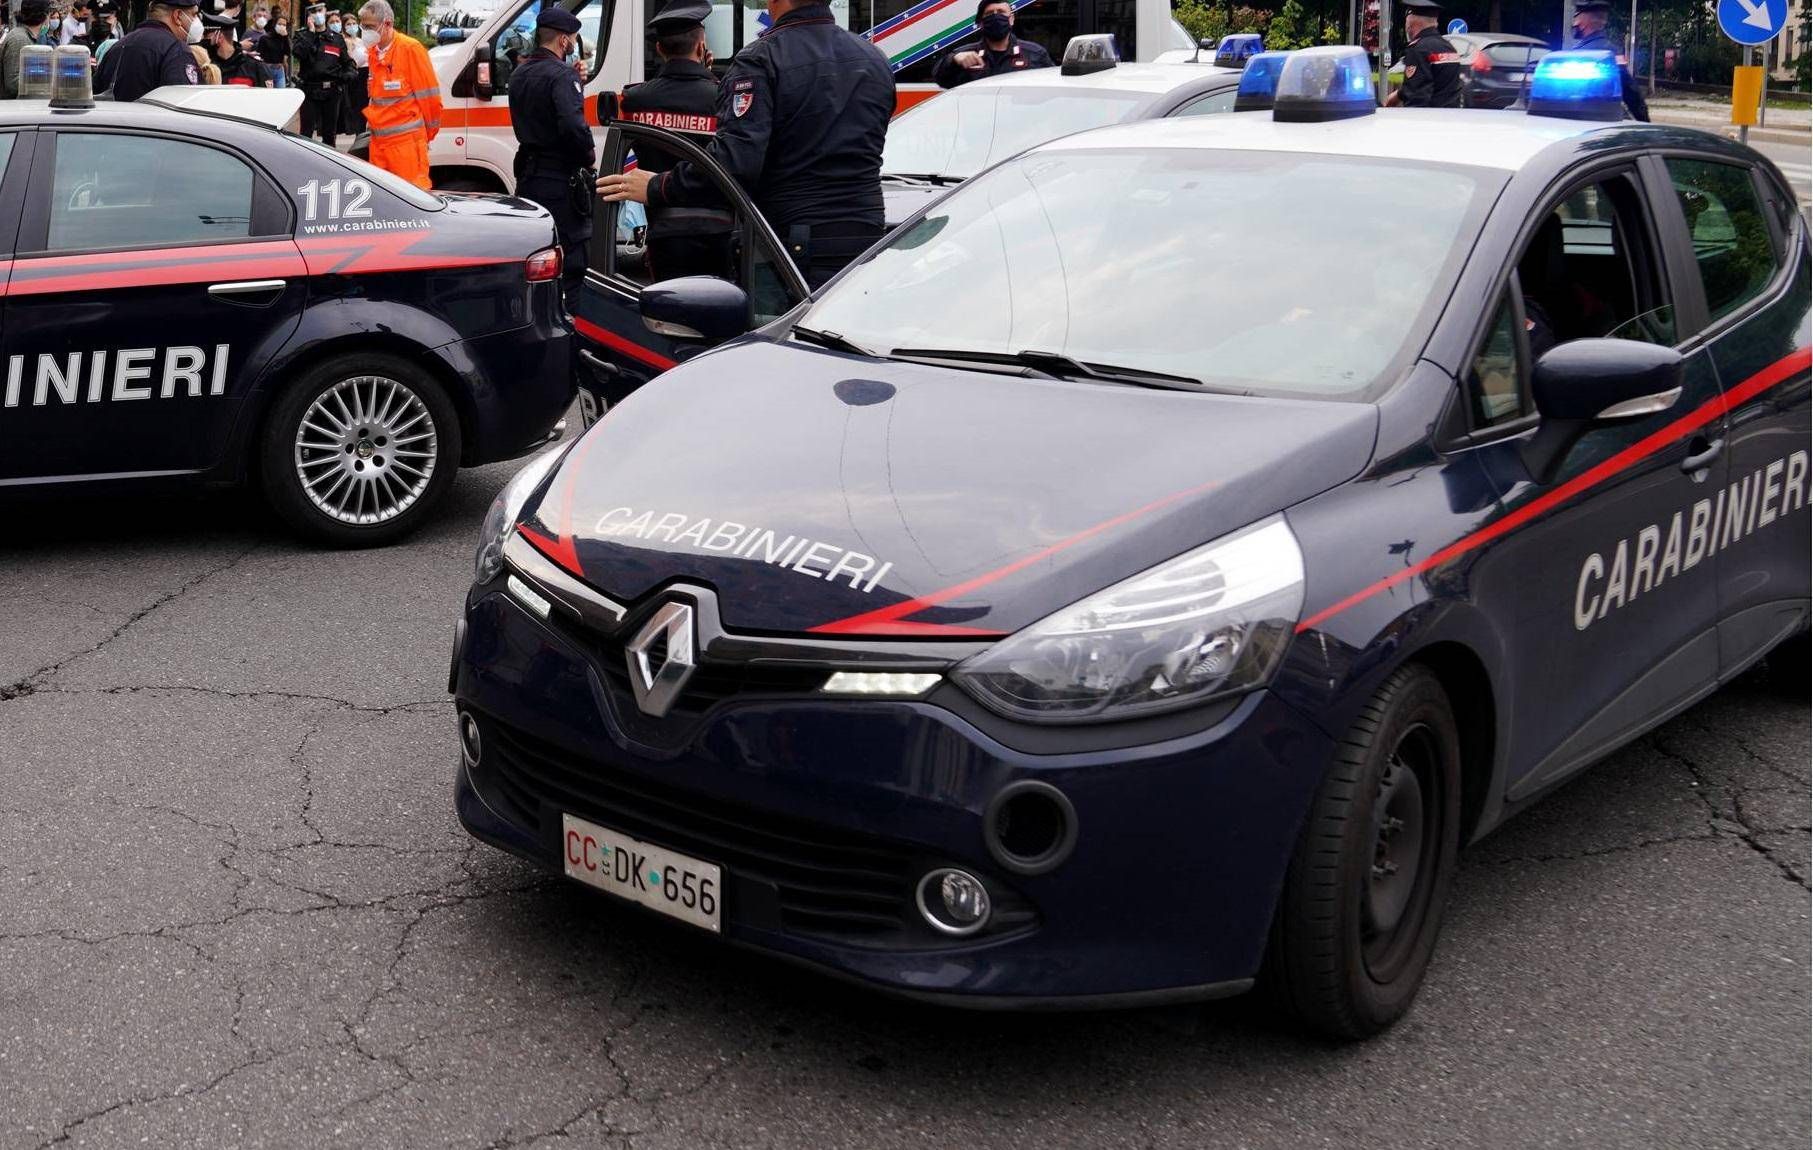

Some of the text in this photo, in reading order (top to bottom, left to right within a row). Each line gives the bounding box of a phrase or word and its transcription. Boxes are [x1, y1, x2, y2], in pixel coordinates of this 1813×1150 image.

[632, 112, 711, 131] CARABINIERI
[297, 179, 372, 220] 112
[304, 219, 431, 234] www.carabinieri.it
[5, 344, 229, 407] INIERI
[594, 507, 893, 593] CARABINIERI
[1574, 449, 1811, 630] CARABINIER
[566, 830, 597, 872] CC
[615, 846, 646, 892] DK
[663, 865, 715, 915] 656
